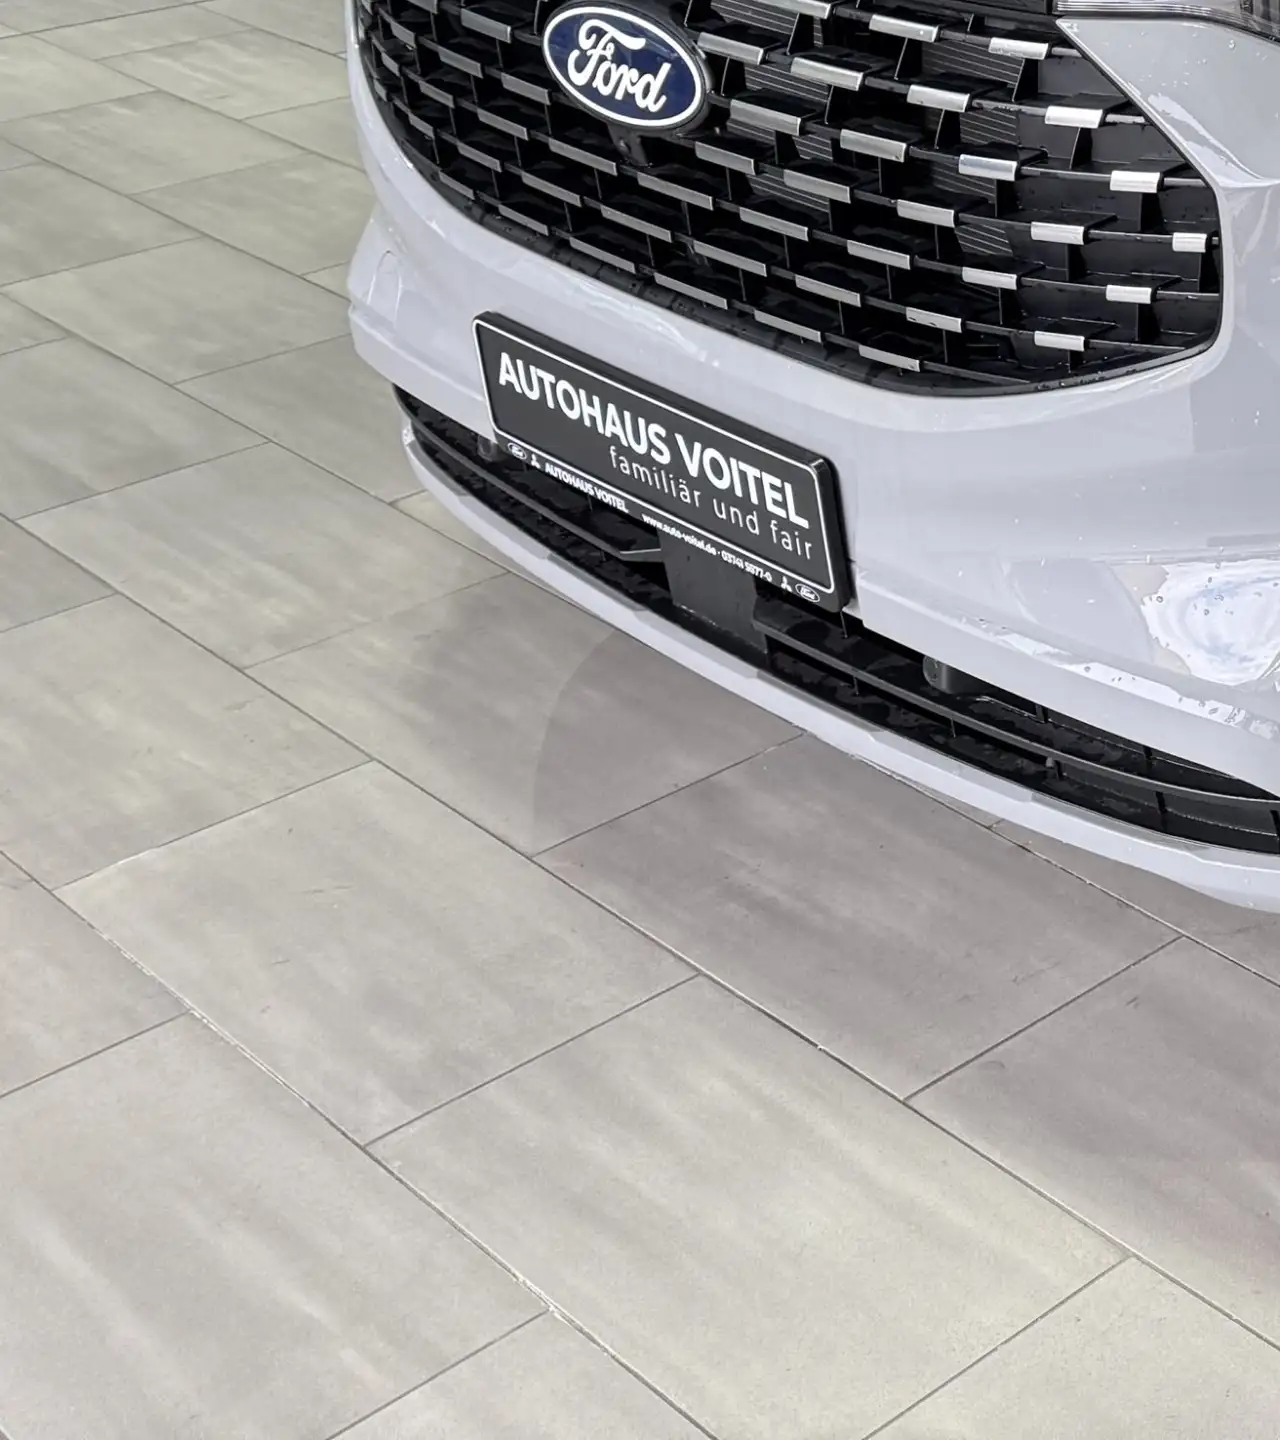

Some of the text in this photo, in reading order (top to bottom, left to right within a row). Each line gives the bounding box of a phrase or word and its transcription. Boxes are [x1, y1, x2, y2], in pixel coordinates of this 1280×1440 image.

[567, 18, 672, 113] Ford
[498, 351, 809, 529] AUTOHAUS VOITEL
[545, 462, 629, 514] AUTOHAUS VOITEL
[609, 445, 813, 560] familiär und fair
